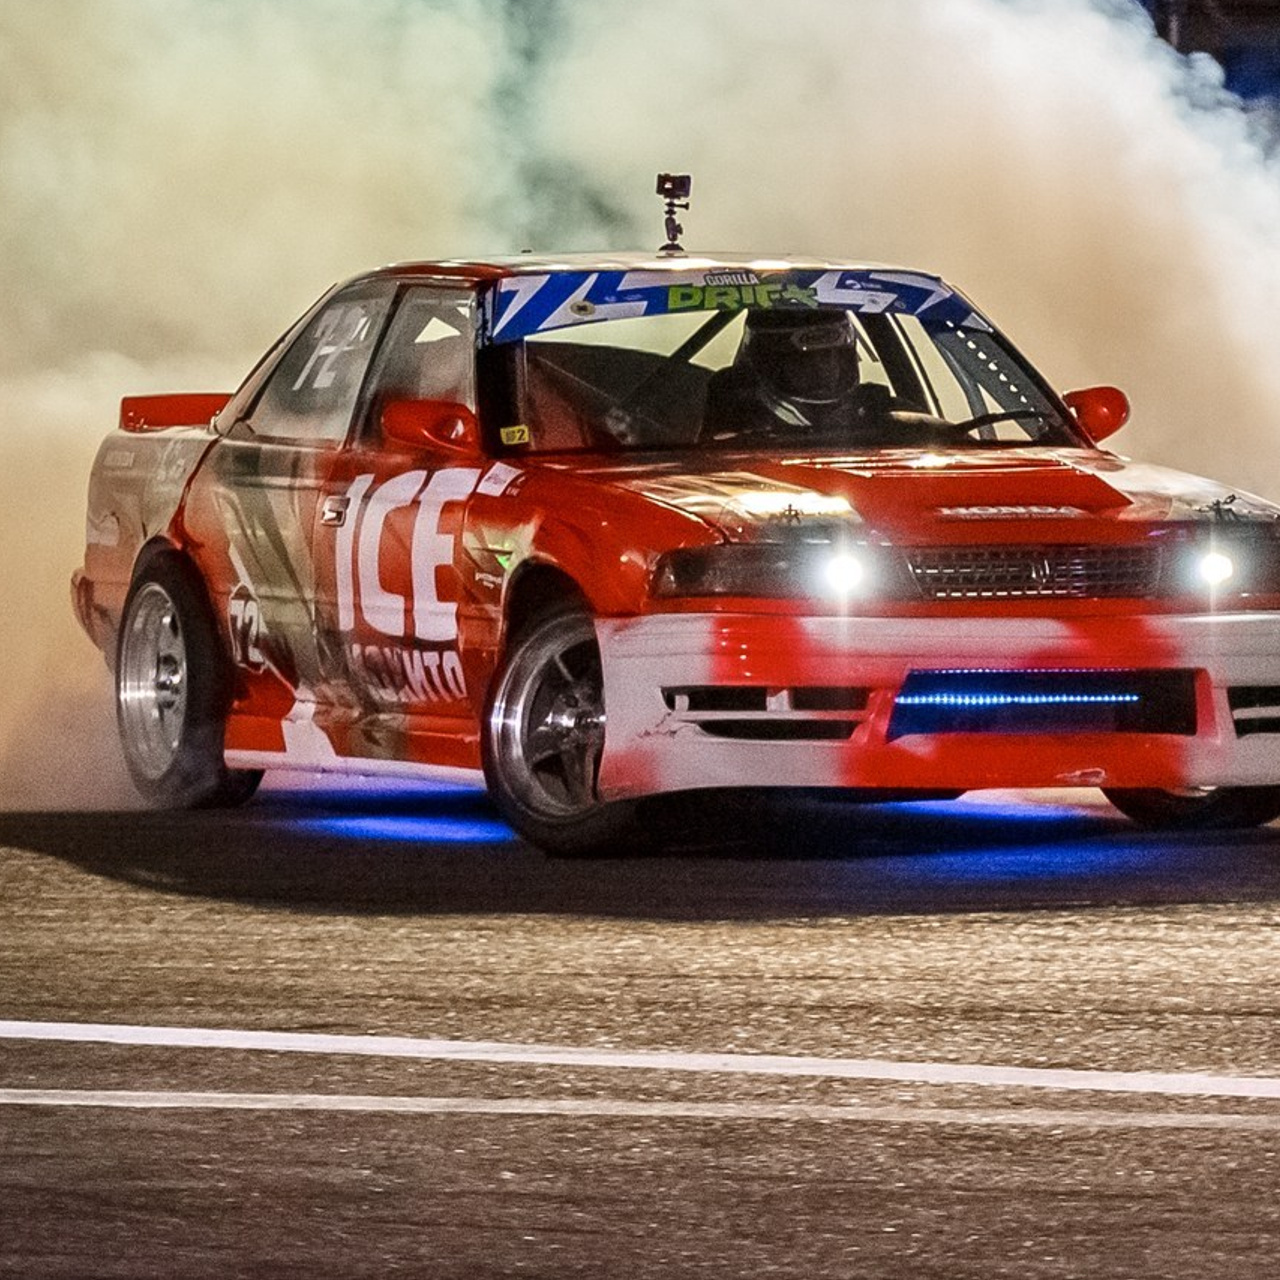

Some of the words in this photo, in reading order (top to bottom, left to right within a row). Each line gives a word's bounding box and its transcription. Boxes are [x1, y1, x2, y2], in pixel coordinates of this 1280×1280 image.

[705, 273, 760, 286] GORILLA
[667, 284, 819, 310] DRIFT
[335, 467, 482, 641] ICE
